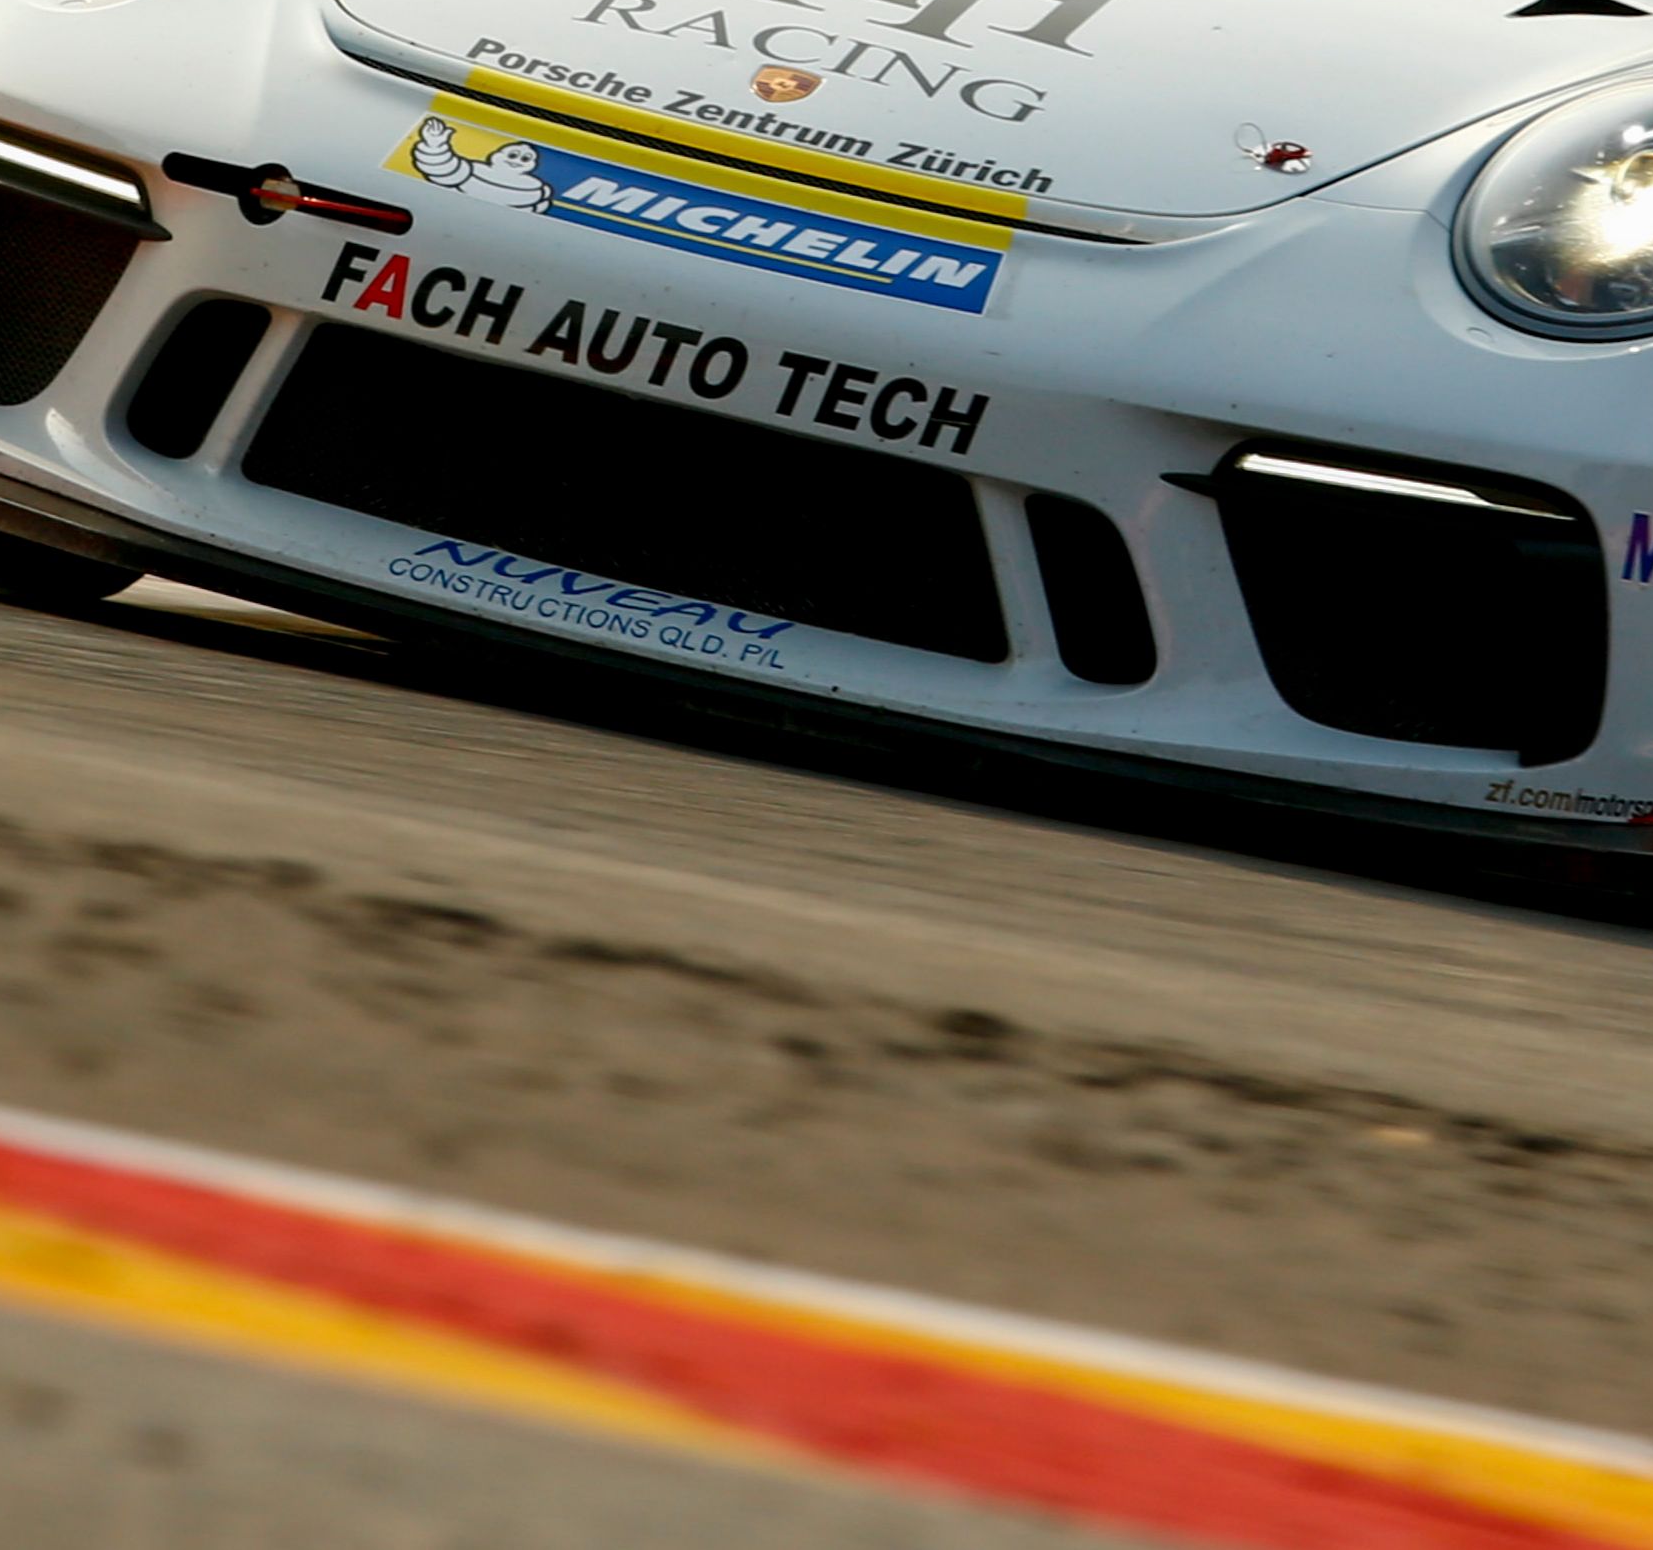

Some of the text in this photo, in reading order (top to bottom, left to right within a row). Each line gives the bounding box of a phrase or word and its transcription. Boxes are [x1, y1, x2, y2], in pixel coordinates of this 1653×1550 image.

[467, 36, 1055, 195] Porsche Zentrum Zürich
[559, 174, 987, 290] MICHELIN
[320, 240, 991, 455] FACH AUTO TECH
[388, 557, 785, 670] CONSTRUCTIONS QLD. P/L
[414, 539, 797, 640] NUVEAU
